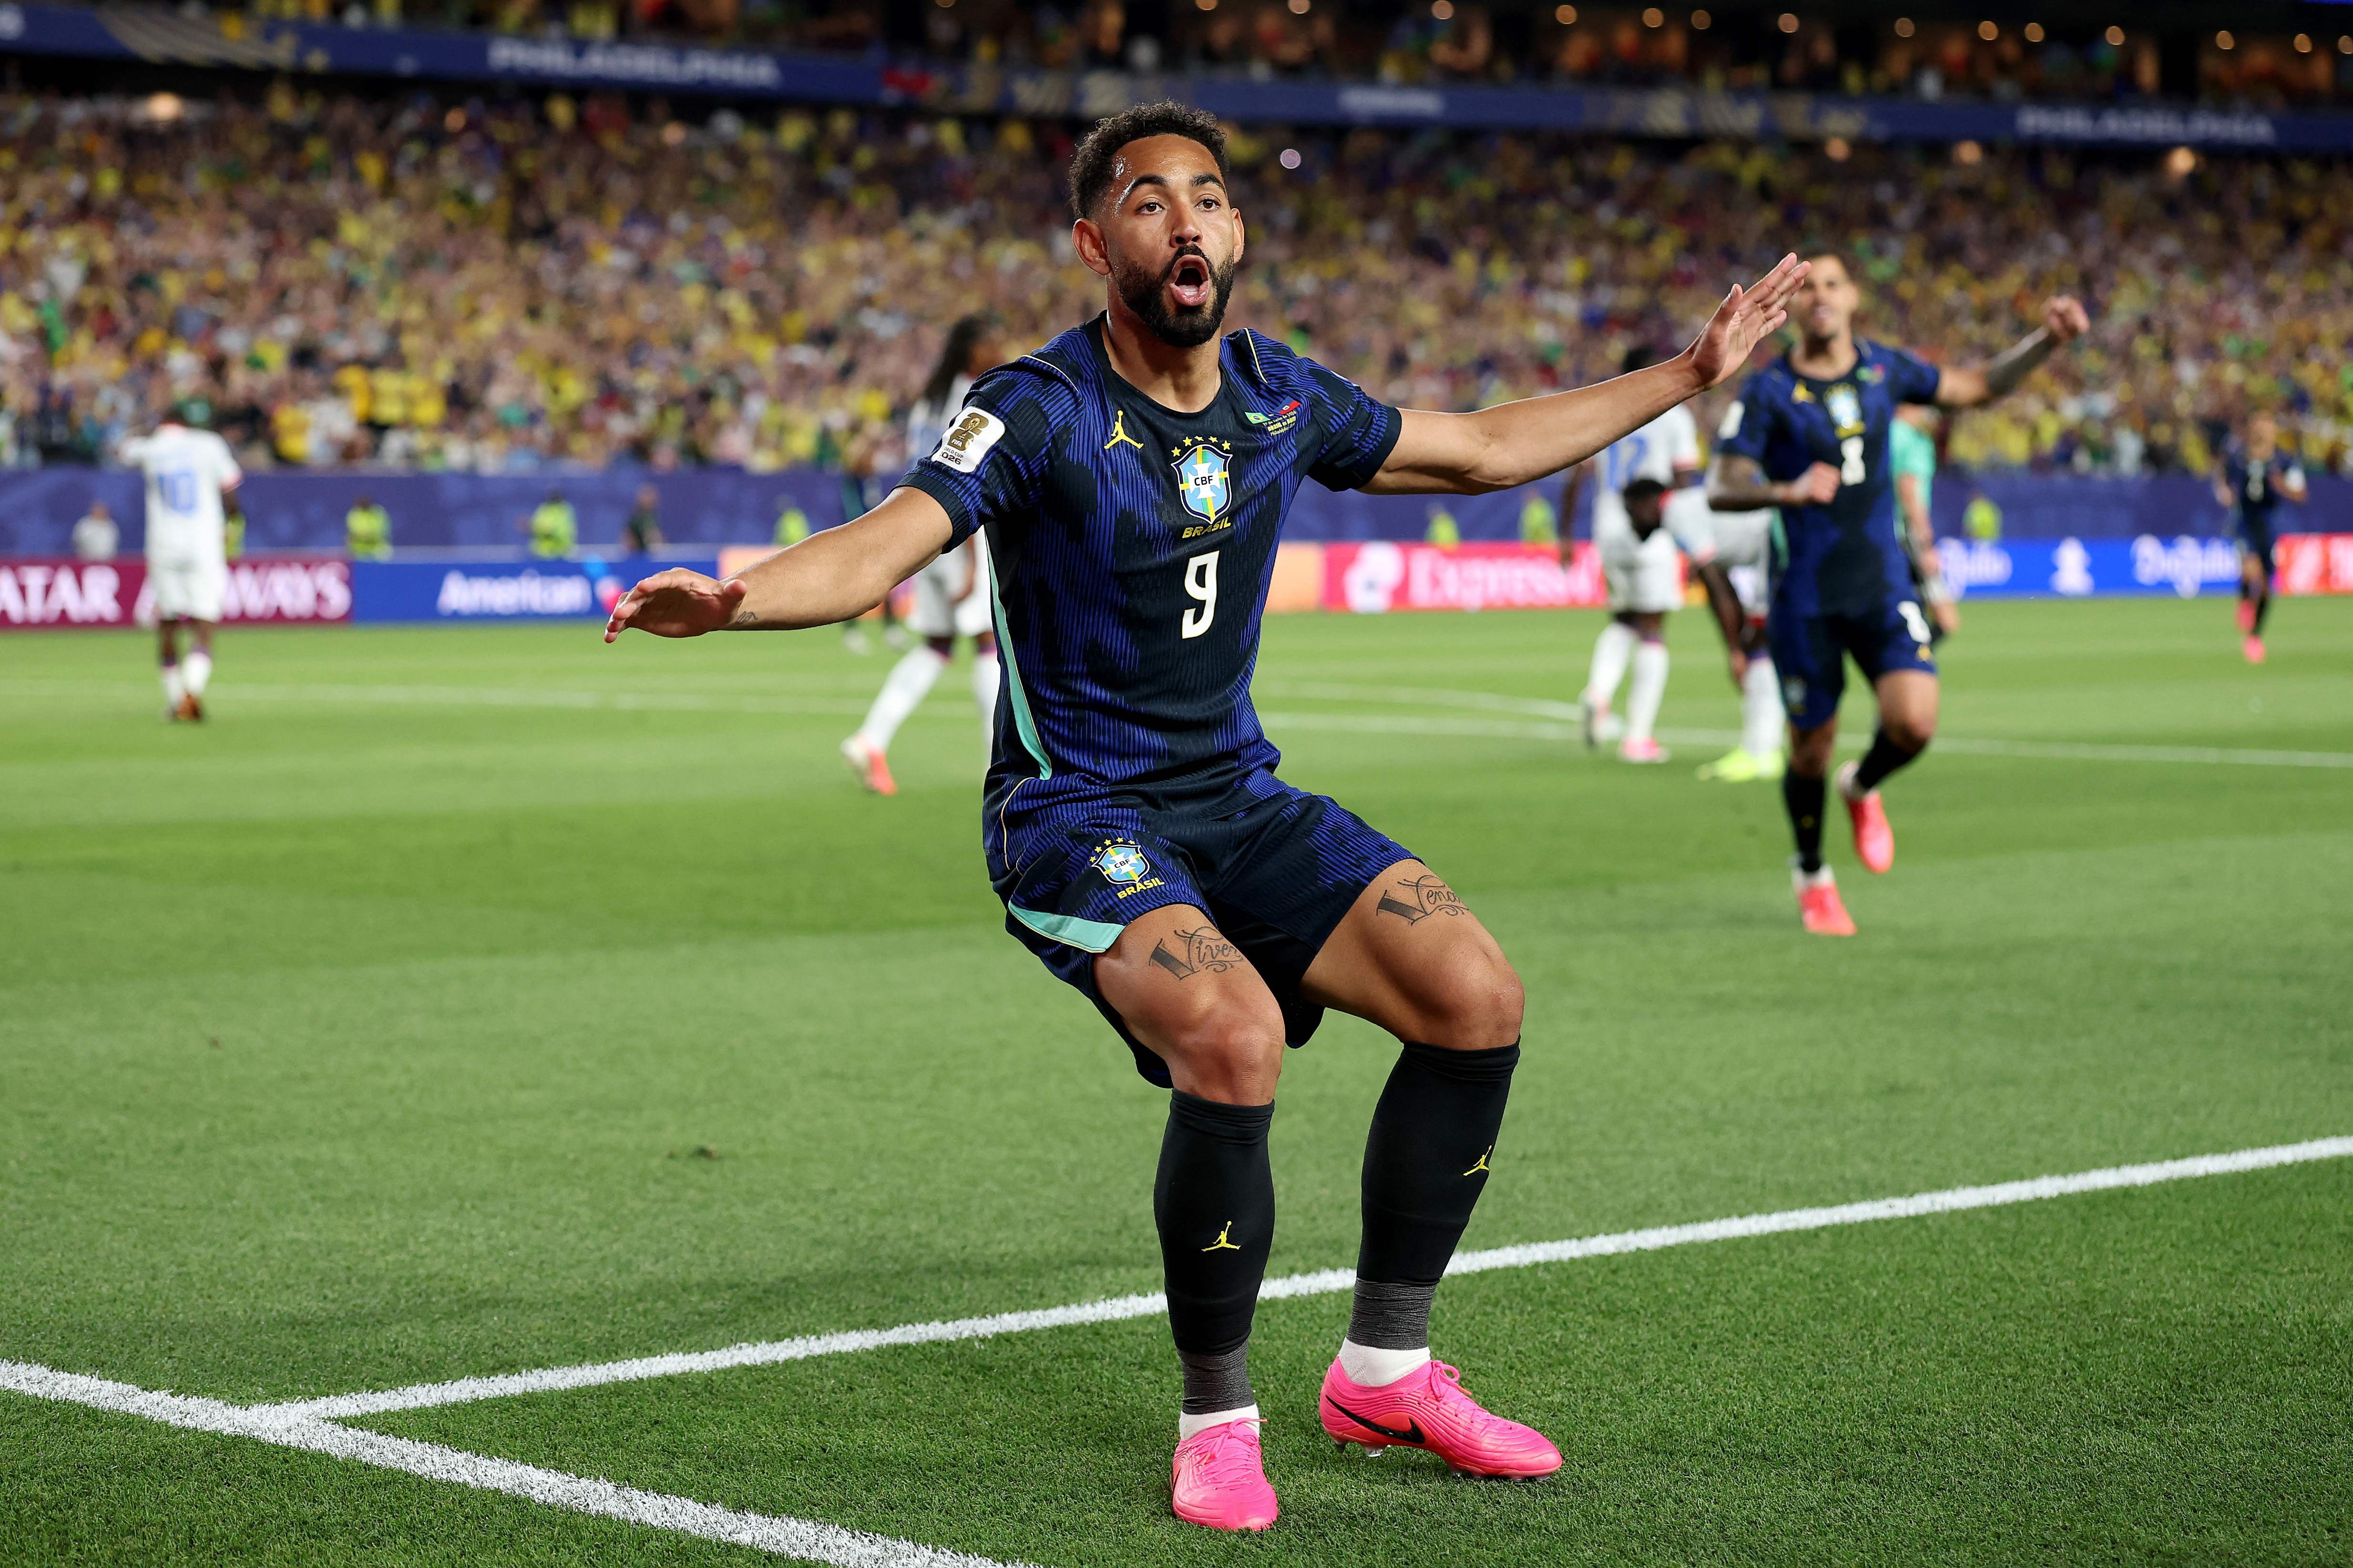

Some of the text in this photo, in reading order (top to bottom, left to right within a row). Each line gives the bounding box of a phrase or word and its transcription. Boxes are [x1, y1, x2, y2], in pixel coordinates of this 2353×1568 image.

[951, 438, 962, 447] FIFA
[940, 451, 962, 465] 026
[1194, 475, 1214, 487] CBF
[1182, 519, 1231, 539] BRASIL
[436, 570, 592, 616] American
[1182, 550, 1220, 639] 9
[1114, 858, 1130, 868] CBF
[1117, 877, 1165, 899] BRASIL
